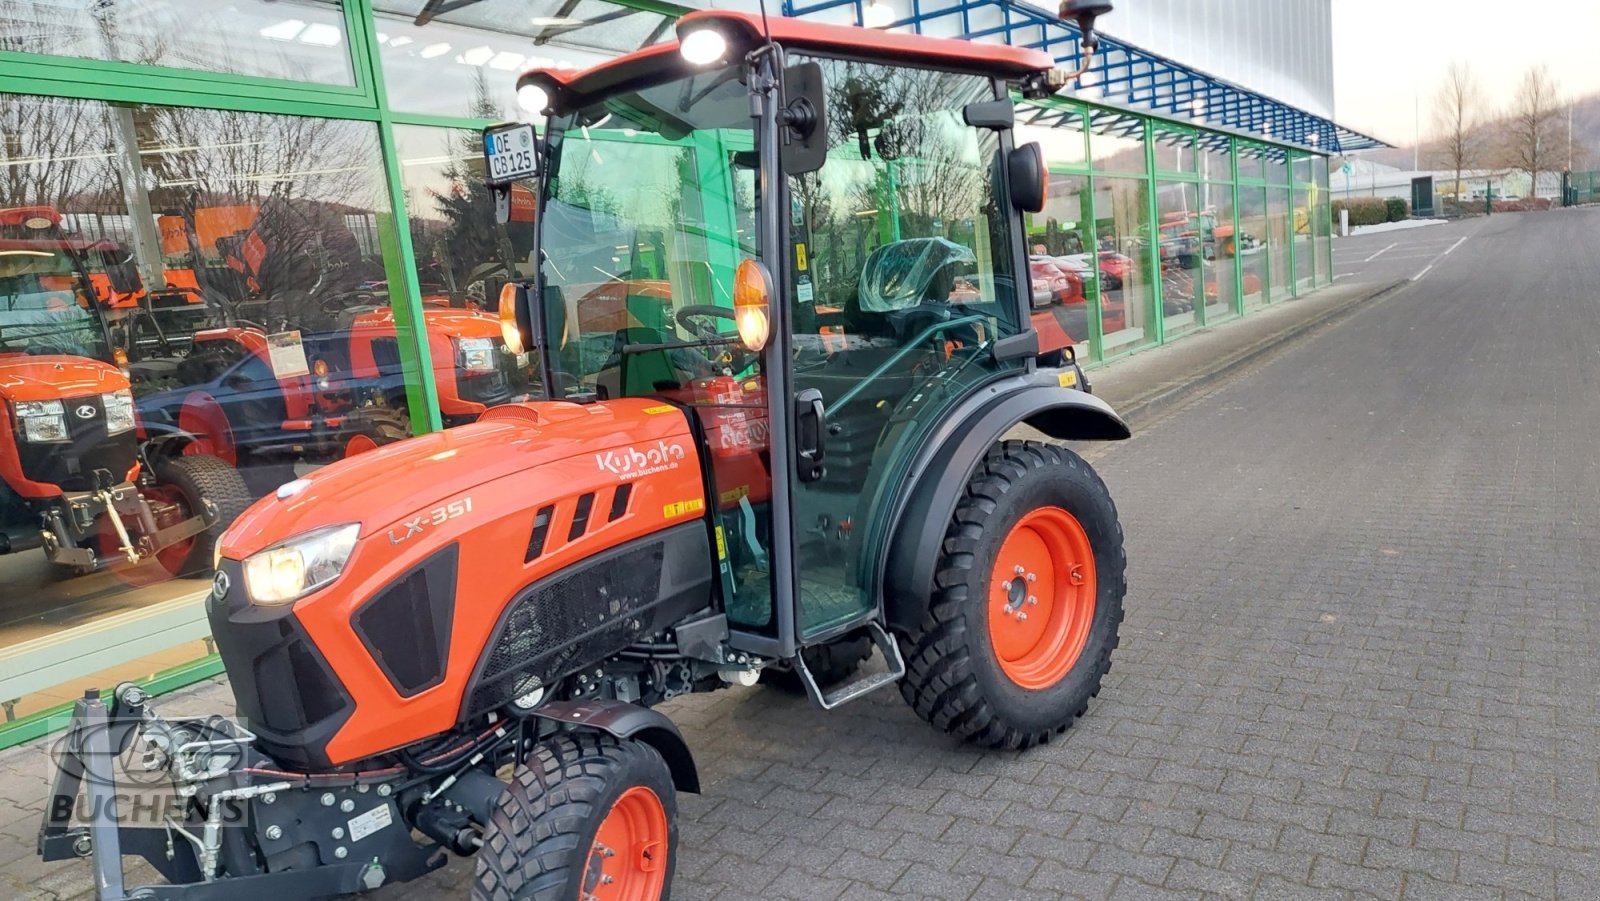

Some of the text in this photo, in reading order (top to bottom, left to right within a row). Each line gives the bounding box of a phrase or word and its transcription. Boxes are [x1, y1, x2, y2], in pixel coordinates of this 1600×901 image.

[594, 440, 685, 474] Kubota
[619, 461, 679, 480] www.buchens.de
[387, 496, 473, 545] LX-351
